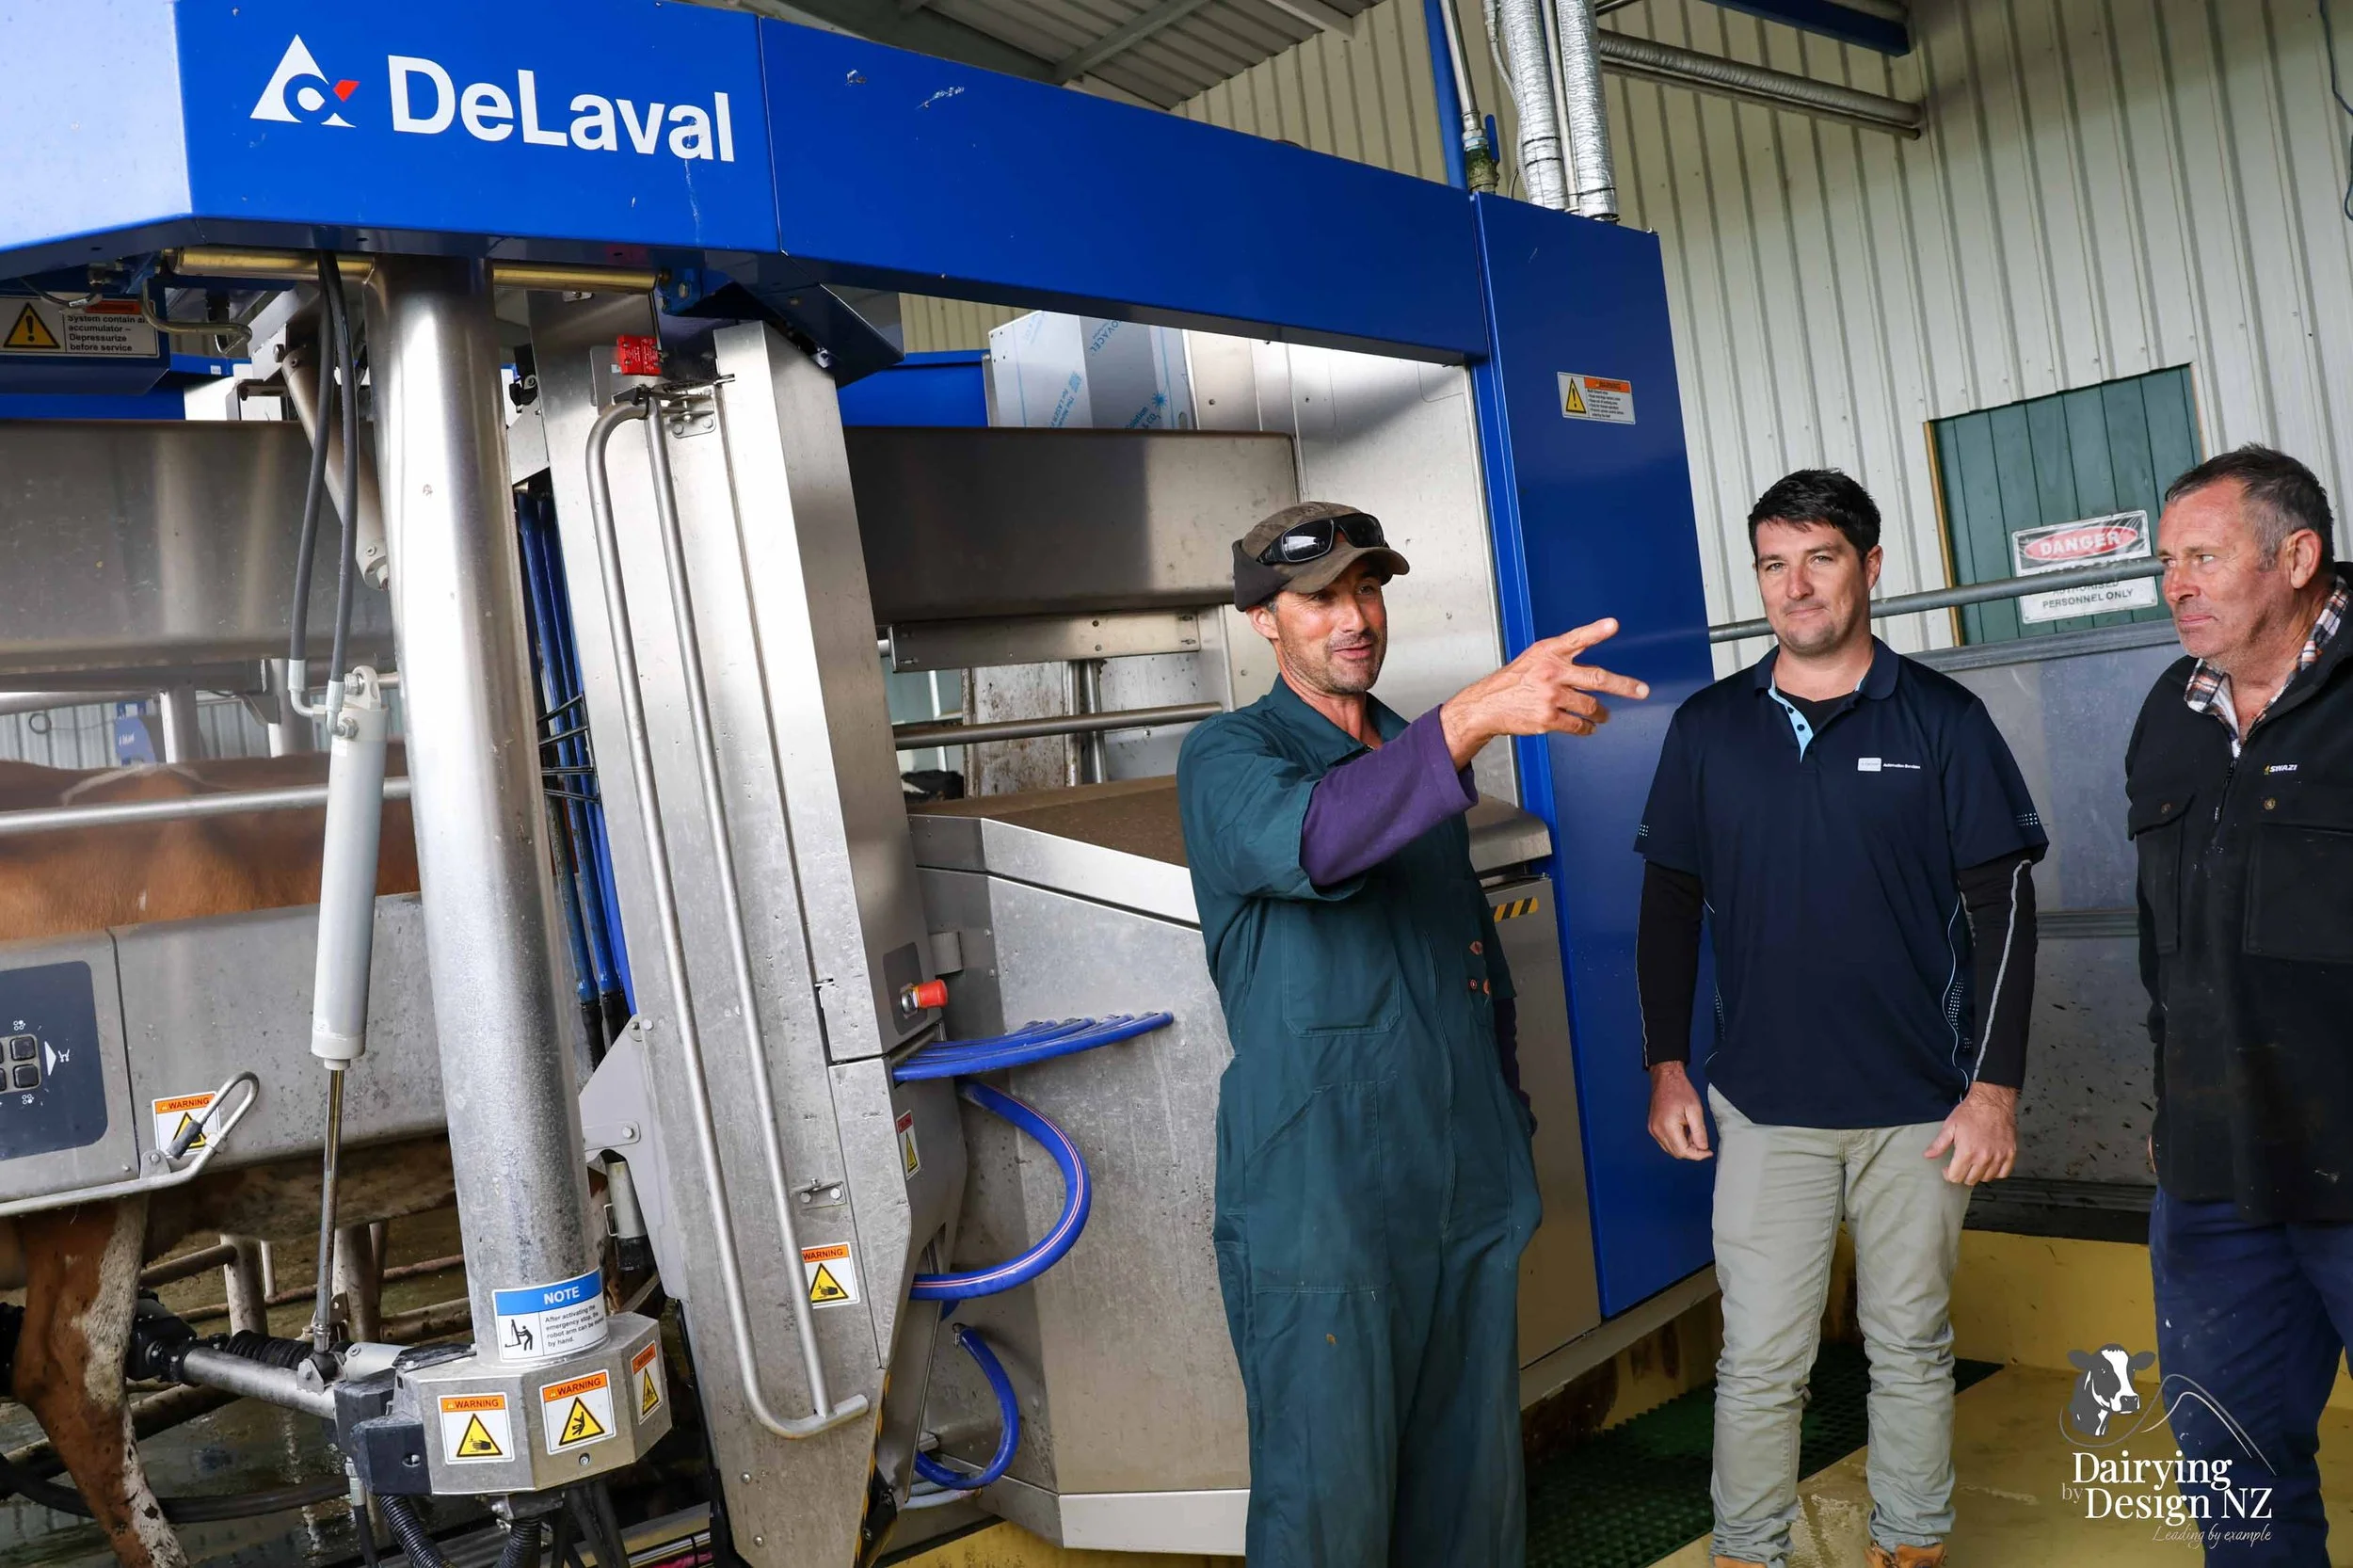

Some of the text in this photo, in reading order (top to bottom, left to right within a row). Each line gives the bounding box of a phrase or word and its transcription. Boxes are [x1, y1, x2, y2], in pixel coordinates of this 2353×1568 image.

[387, 54, 735, 163] DeLaval
[68, 315, 101, 324] System
[103, 315, 136, 324] contain
[68, 325, 123, 333] accumulator
[69, 333, 127, 343] Depressurize
[1089, 319, 1122, 353] OVACEL
[2040, 533, 2121, 555] DANGER
[2042, 588, 2134, 609] PERSONNEL ONLY
[168, 1097, 209, 1110] WARNING
[802, 1248, 843, 1260] WARNING
[543, 1286, 580, 1304] NOTE
[562, 1307, 588, 1319] activating
[546, 1320, 579, 1331] emergency
[557, 1378, 601, 1396] WARNING
[455, 1399, 499, 1409] WARNING
